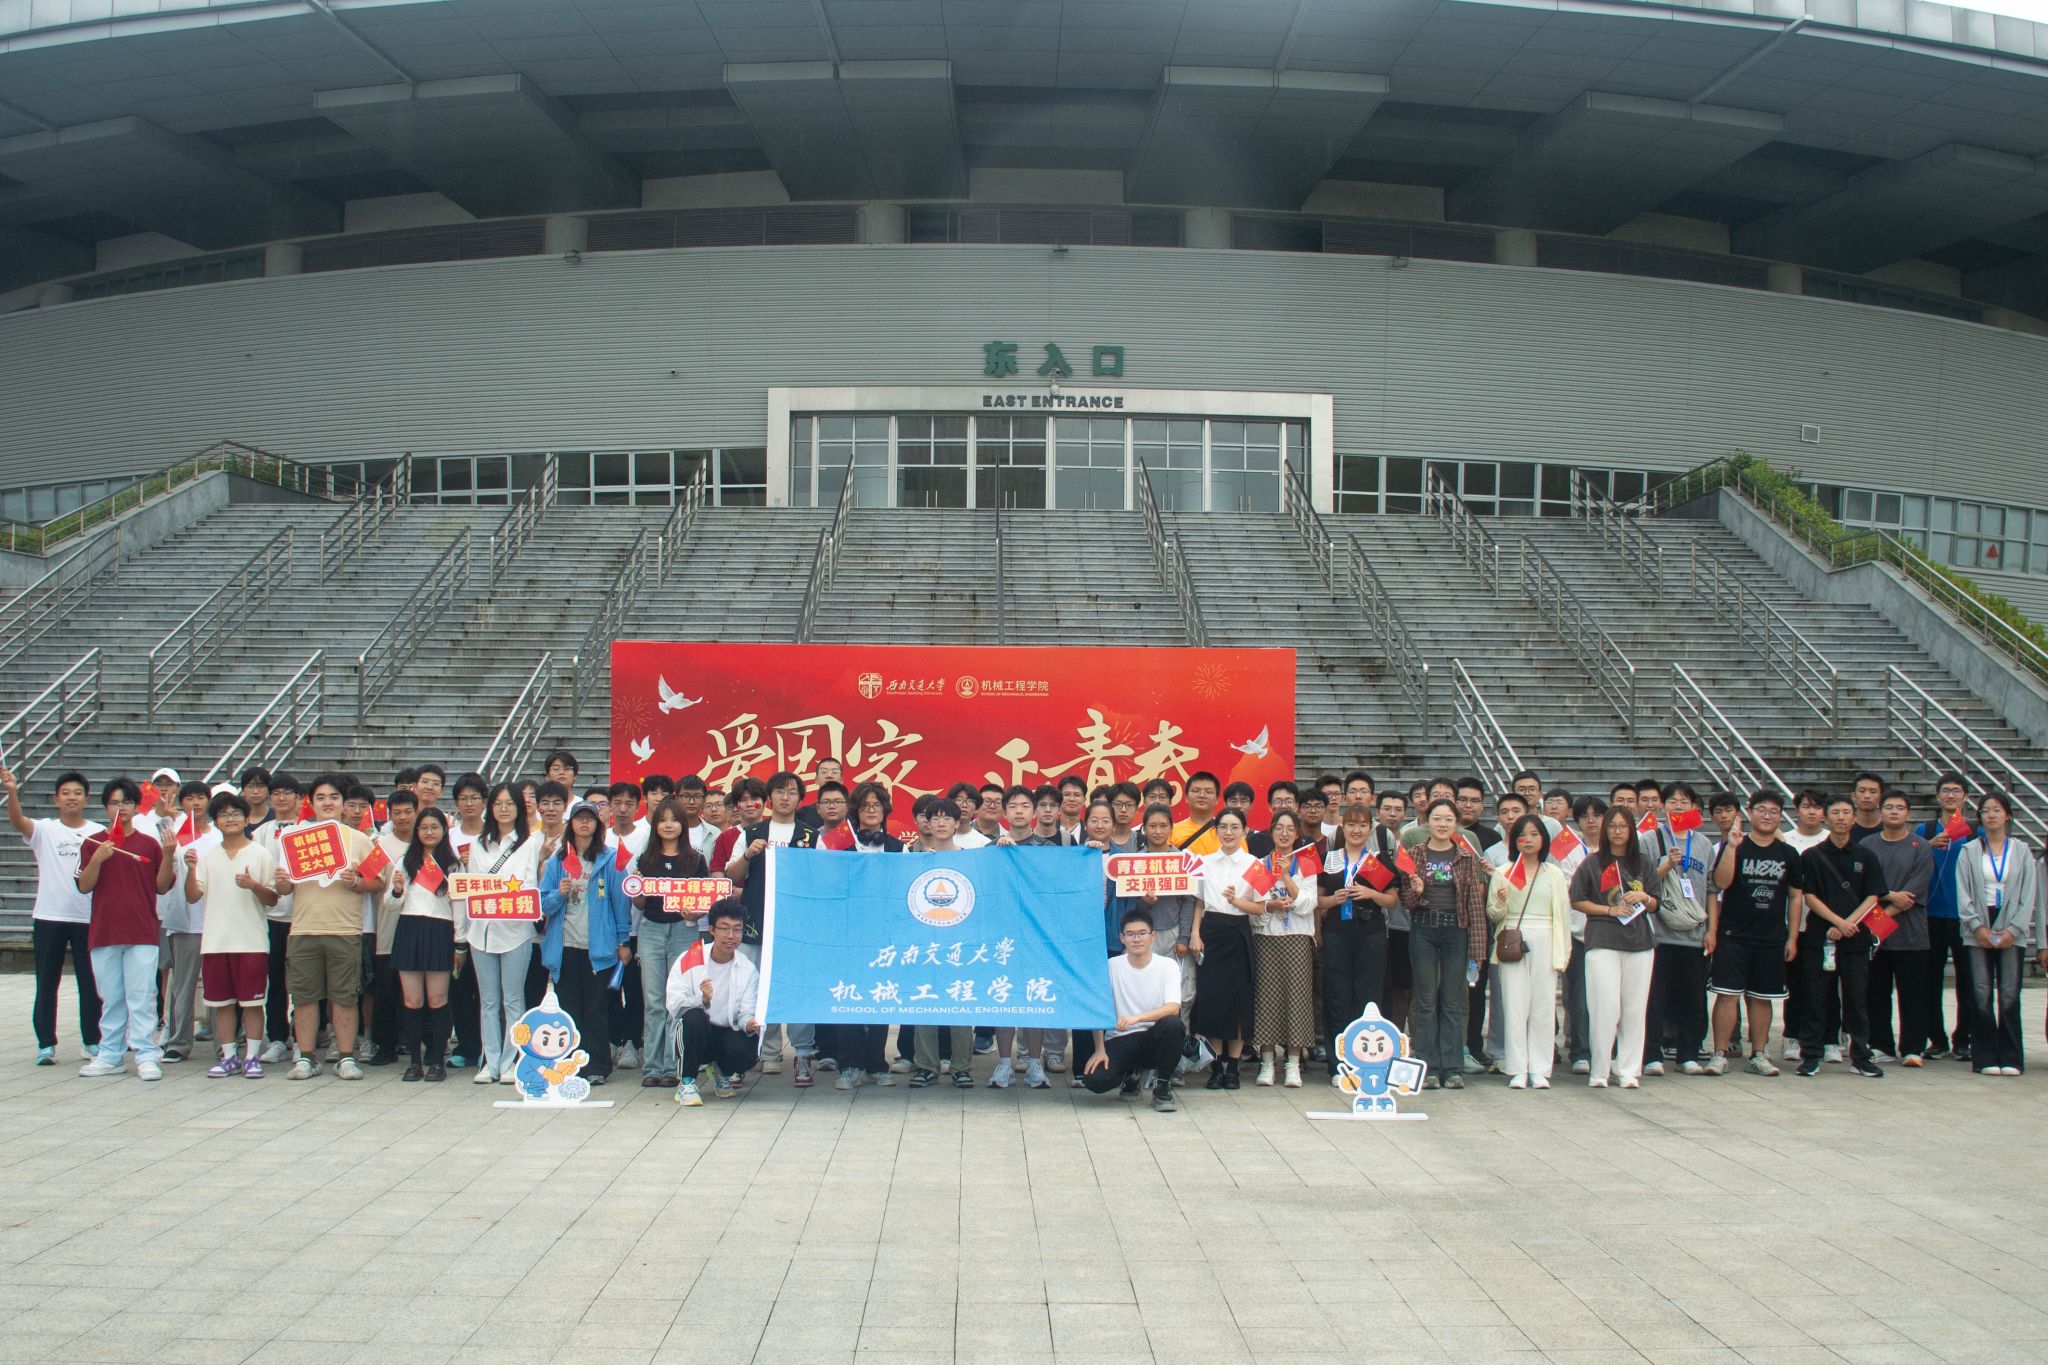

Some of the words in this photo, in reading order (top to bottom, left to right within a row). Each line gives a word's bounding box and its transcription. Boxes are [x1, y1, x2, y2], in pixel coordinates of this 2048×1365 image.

[984, 340, 1124, 378] 东入口
[982, 395, 1027, 408] EAST
[1031, 395, 1124, 409] ENTRANCE
[981, 679, 1049, 691] 机械工程学院
[300, 854, 336, 873] 交大强
[1117, 858, 1180, 875] 青春机械
[455, 879, 503, 893] 百年机械
[643, 880, 730, 894] 机械工程学院
[1126, 876, 1188, 892] 交通强国
[471, 895, 534, 915] 青春有我
[829, 975, 1057, 1005] 机械工程学院
[830, 1005, 879, 1014] SCHOOL
[880, 1005, 896, 1014] OF
[898, 1006, 973, 1014] MECHANICAL
[975, 1005, 1056, 1015] ENGINEERING
